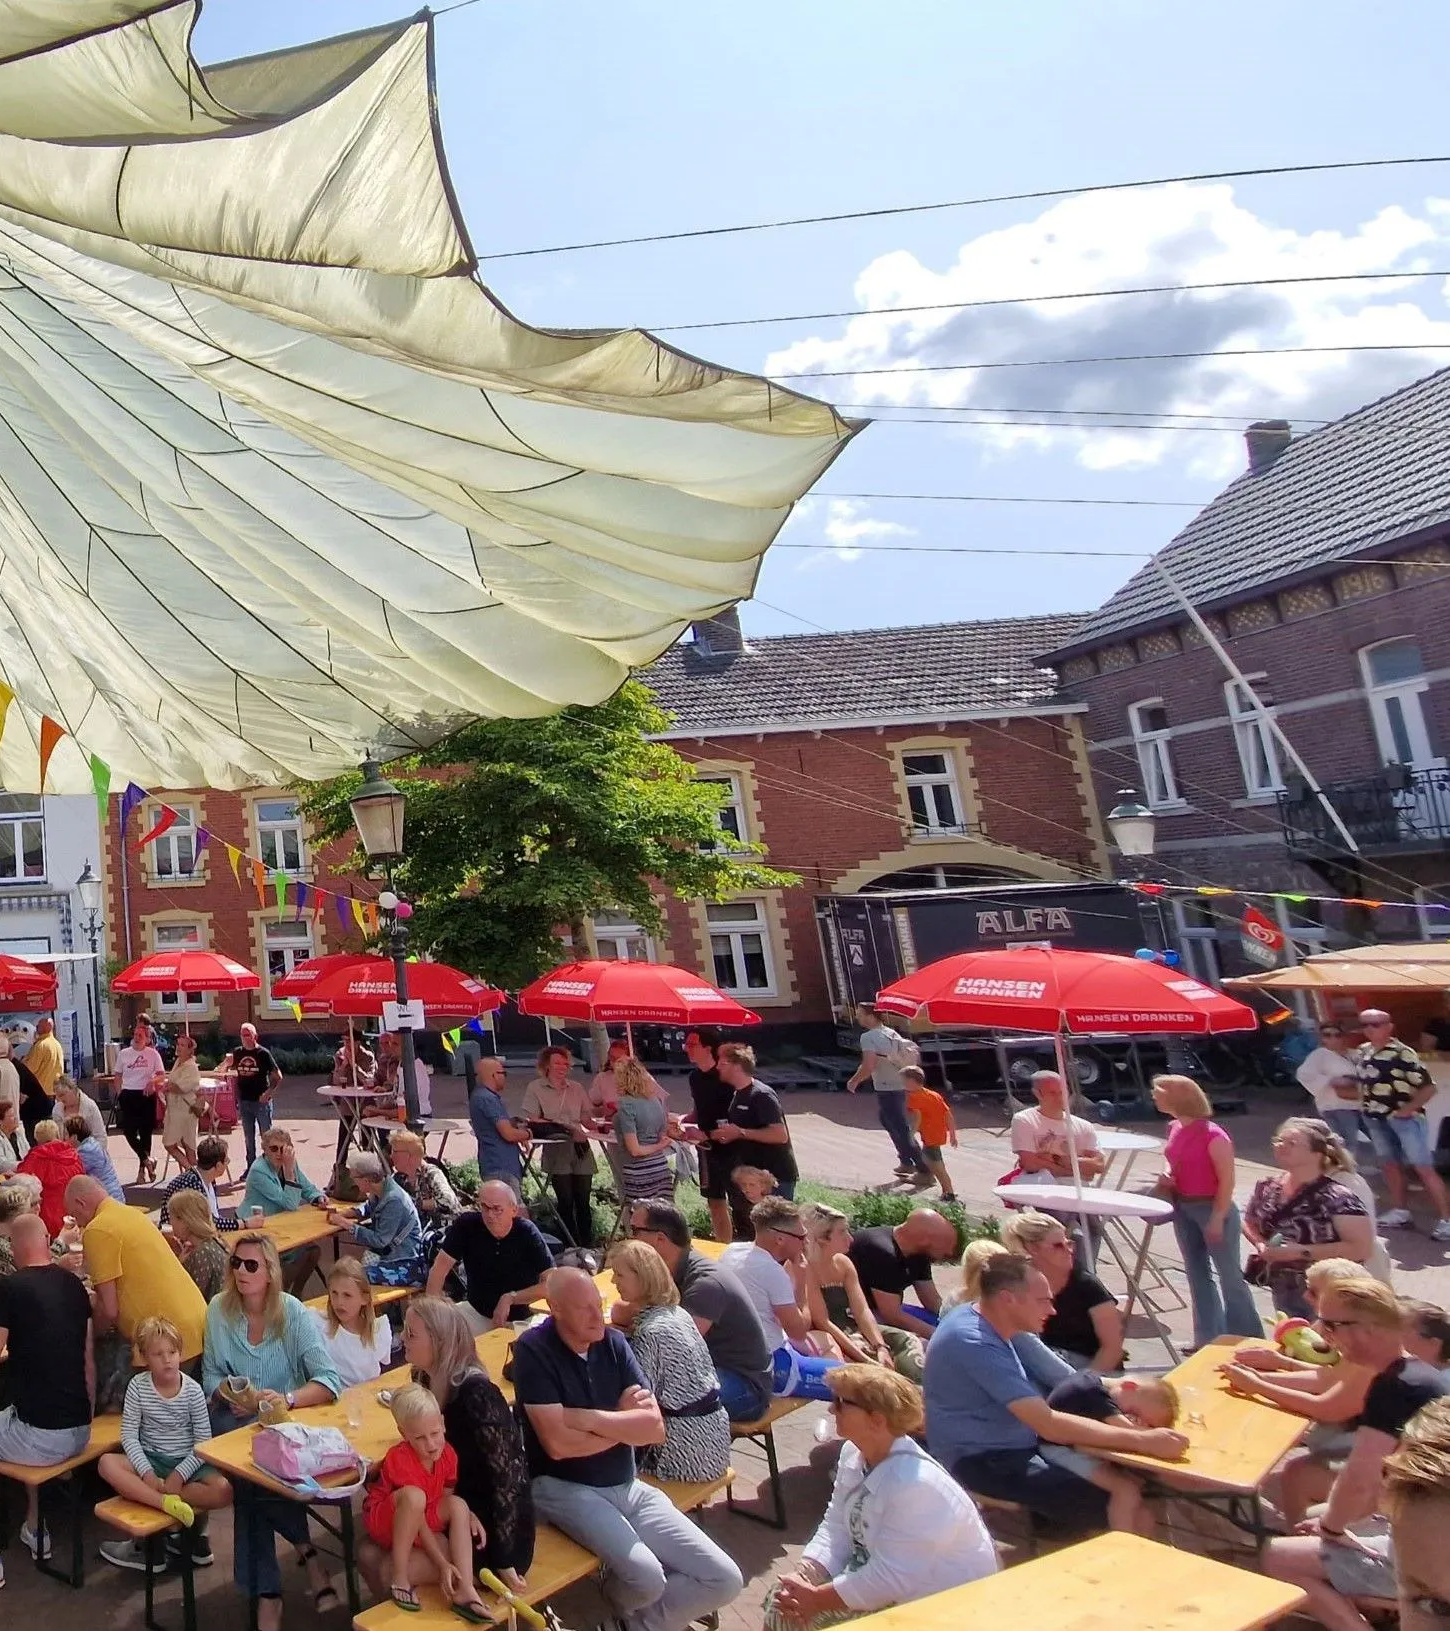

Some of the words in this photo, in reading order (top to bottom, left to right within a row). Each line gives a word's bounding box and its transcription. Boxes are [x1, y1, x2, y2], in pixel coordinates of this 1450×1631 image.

[976, 907, 1071, 934] ALFA
[349, 981, 397, 989] HANSEN
[546, 980, 595, 990] HANSEN
[957, 977, 1047, 991] HANSEN
[542, 987, 590, 996] DRANKEN
[953, 986, 1043, 999] DRANKEN
[1076, 1014, 1130, 1022] HANSEN
[1132, 1013, 1195, 1022] DRANKEN
